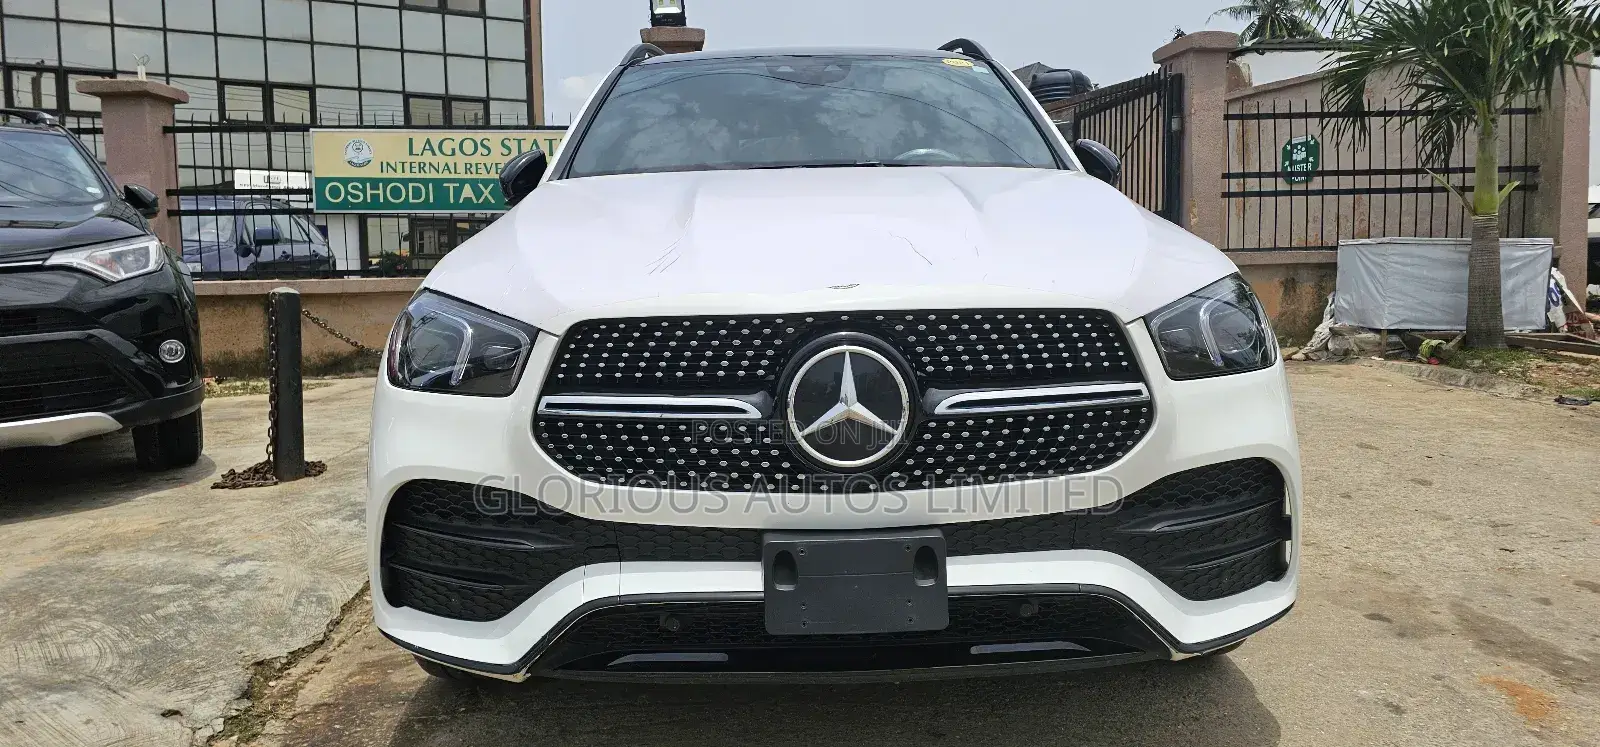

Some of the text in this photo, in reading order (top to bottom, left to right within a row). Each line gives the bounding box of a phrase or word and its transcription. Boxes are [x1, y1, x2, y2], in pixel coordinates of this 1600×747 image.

[408, 137, 563, 157] LAGOS STAT
[380, 161, 507, 175] INTERNAL REVE
[324, 181, 496, 204] OSHODI TAX
